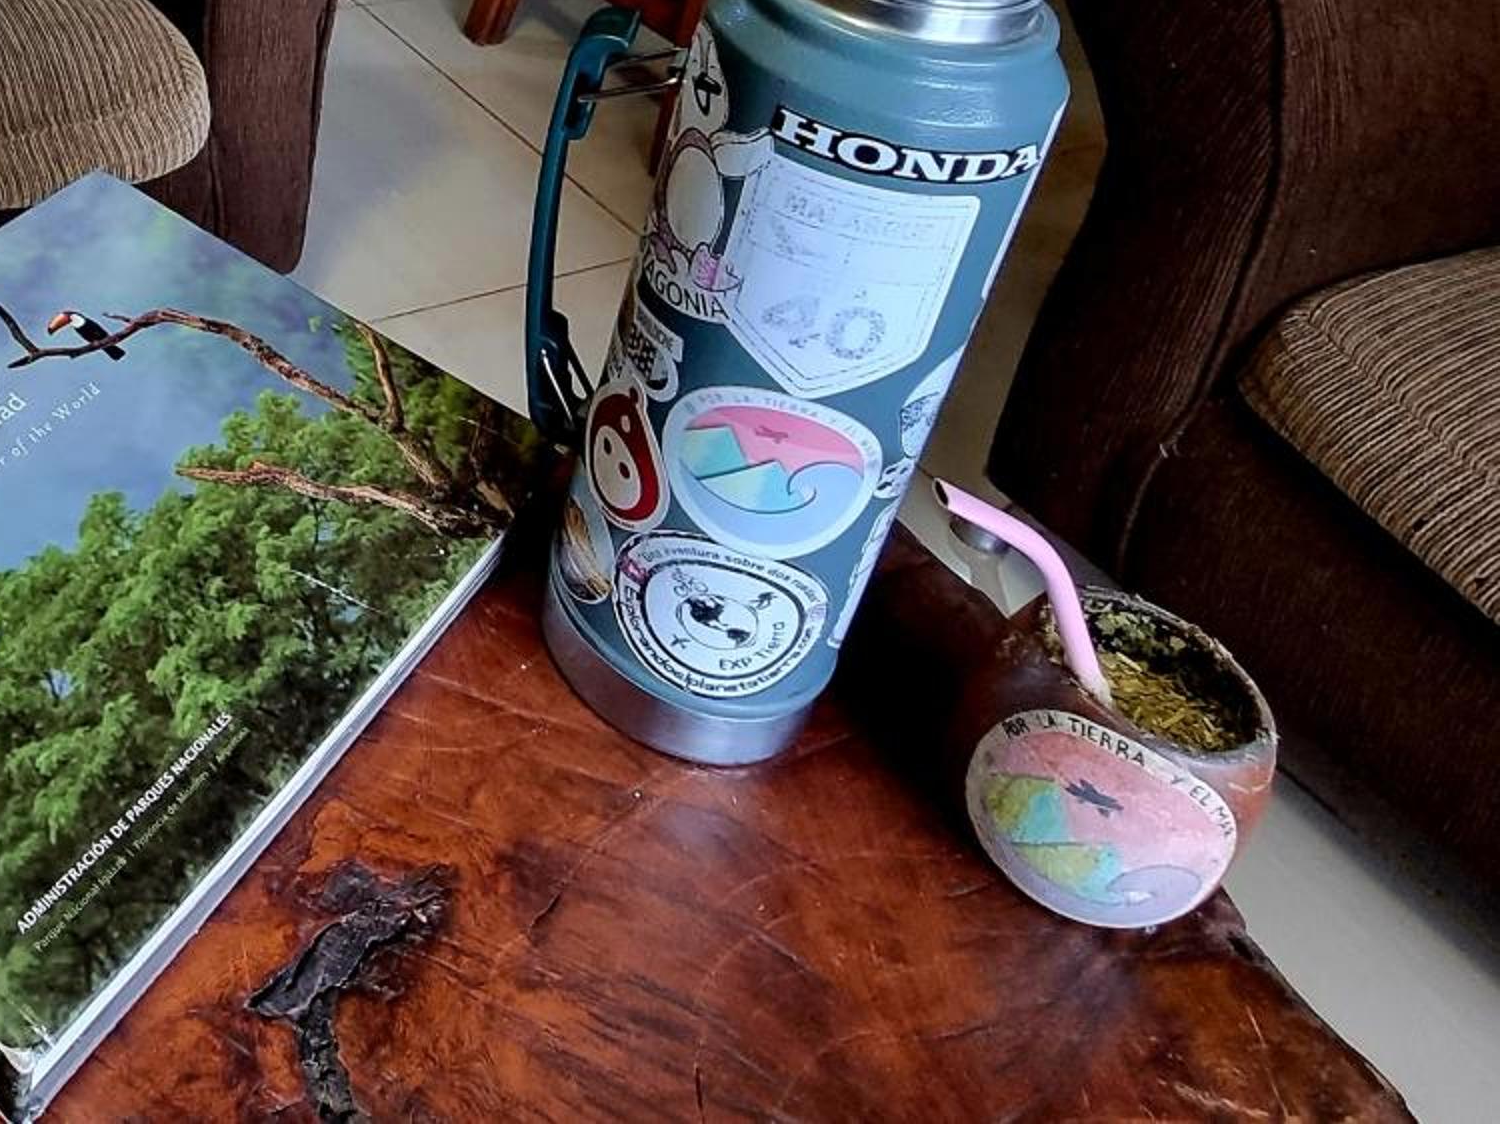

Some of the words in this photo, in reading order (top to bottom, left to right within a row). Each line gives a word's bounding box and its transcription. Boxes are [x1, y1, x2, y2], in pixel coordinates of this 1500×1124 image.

[779, 109, 1041, 182] HONDA
[11, 436, 29, 458] of
[28, 422, 53, 444] the
[52, 380, 102, 421] World
[724, 554, 765, 572] sobre
[767, 566, 790, 584] dos
[1002, 716, 1031, 739] POR
[1035, 712, 1057, 729] LA
[1067, 716, 1146, 767] TIERRA
[1189, 785, 1211, 807] EL
[16, 834, 114, 935] ADMINISTRACIÓN
[109, 817, 131, 839] DE
[125, 771, 175, 823] PARQUES
[169, 711, 233, 776] NACIONALES
